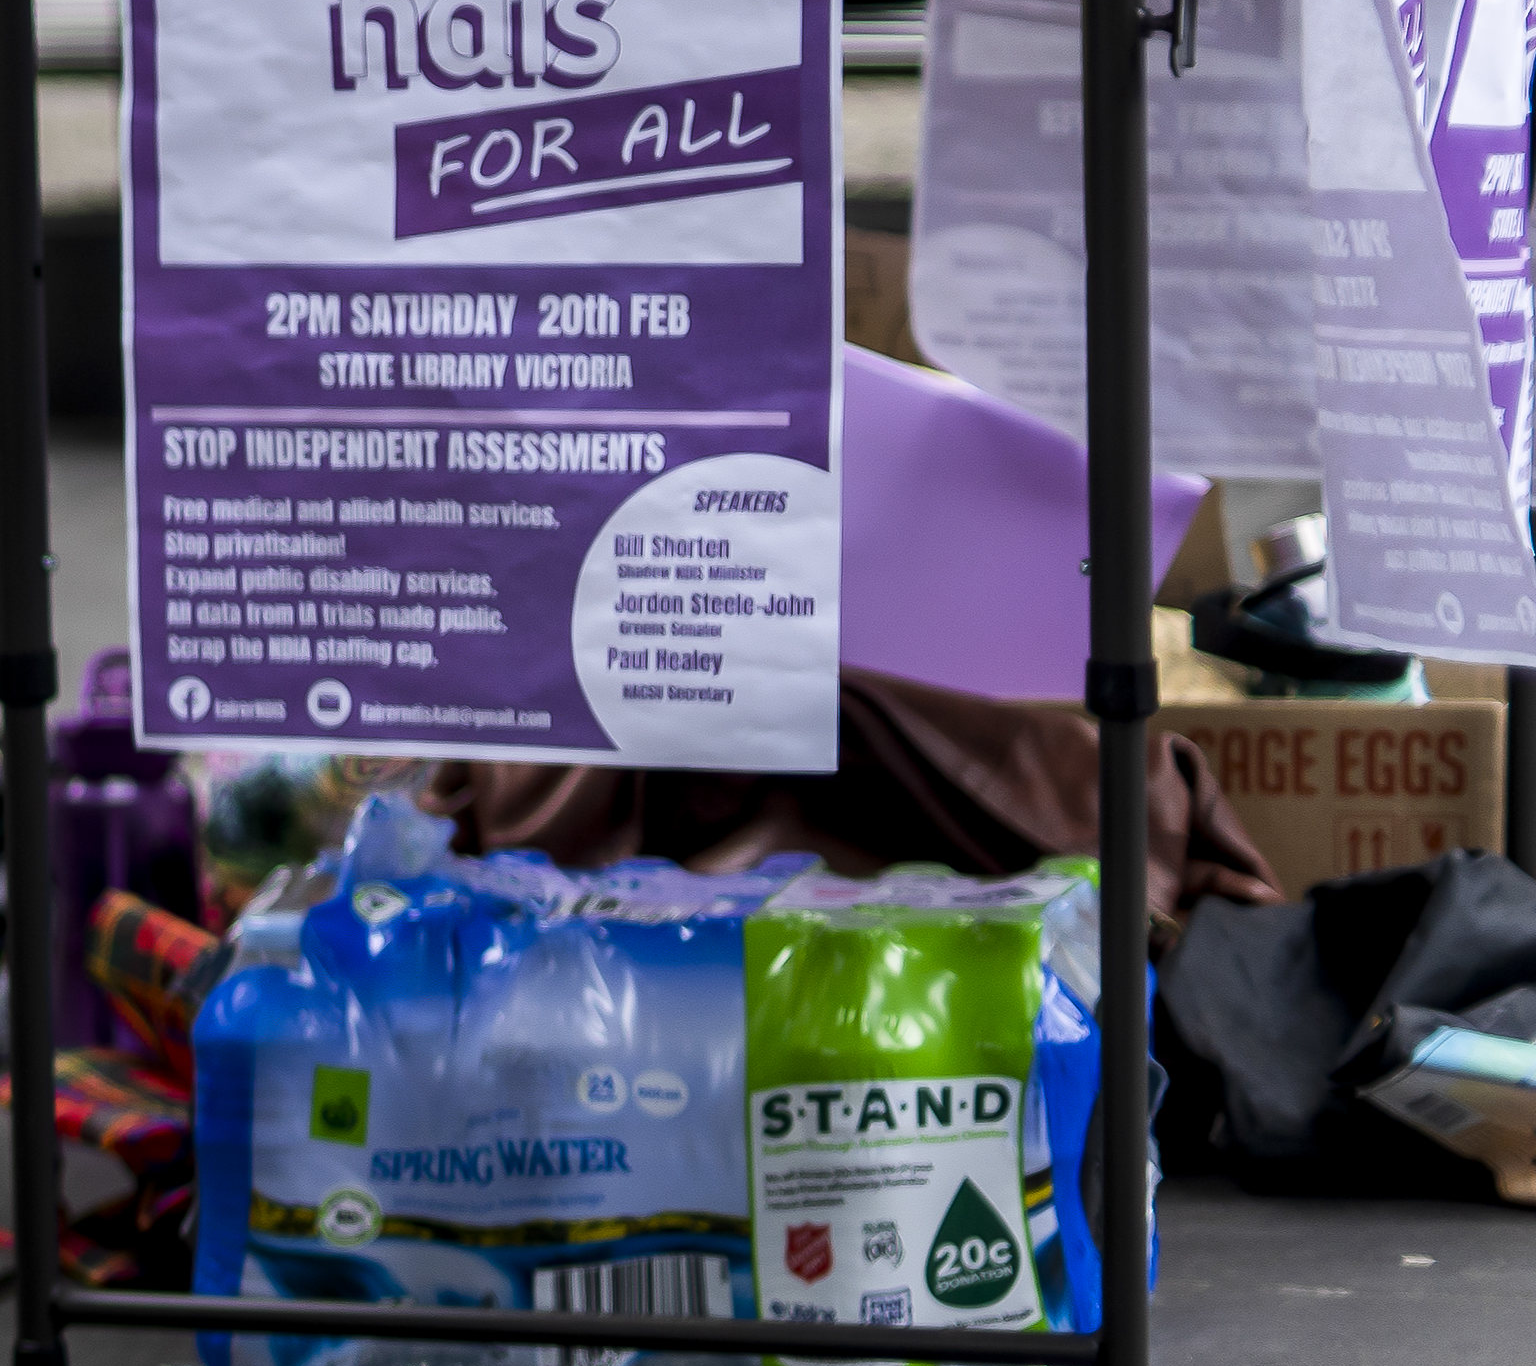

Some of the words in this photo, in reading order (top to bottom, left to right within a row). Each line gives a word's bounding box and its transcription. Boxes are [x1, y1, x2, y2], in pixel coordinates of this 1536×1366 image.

[429, 117, 579, 197] FOR
[622, 90, 772, 165] ALL
[266, 292, 341, 337] 2PM
[350, 292, 519, 338] SATURDAY
[538, 292, 621, 338] 20th
[630, 293, 691, 338] FEB
[318, 352, 395, 389] STATE
[401, 352, 510, 390] LIBRARY
[514, 354, 634, 390] VICTORIA
[163, 428, 238, 470] STOP
[244, 429, 440, 470] INDEPENDENT
[447, 432, 667, 473] ASSESSMENTS
[163, 495, 209, 523] Free
[212, 498, 292, 524] medical
[297, 498, 335, 524] and
[338, 497, 396, 525] allied
[400, 498, 465, 525] health
[468, 501, 561, 529] services.
[694, 490, 789, 513] SPEAKERS
[164, 531, 210, 559] Stop
[614, 534, 644, 557] Bill
[652, 536, 730, 559] Shorten
[165, 565, 237, 595] Expand
[241, 567, 305, 596] public
[309, 566, 402, 597] disability
[406, 570, 498, 597] services.
[166, 600, 192, 627] All
[196, 601, 242, 627] data
[246, 601, 294, 628] from
[321, 601, 376, 629] trials
[379, 603, 436, 631] made
[439, 606, 509, 635] public.
[614, 592, 684, 615] Jordon
[691, 593, 816, 617] Steele-John
[167, 635, 226, 666] Scrap
[230, 635, 264, 662] the
[316, 637, 393, 668] staffing
[396, 641, 439, 669] cap.
[607, 647, 649, 670] Paul
[656, 649, 724, 676] Healey
[1336, 729, 1468, 798] EGGS
[369, 1144, 492, 1186] SPRING
[495, 1136, 633, 1179] WATER
[936, 1266, 1015, 1294] DONATION
